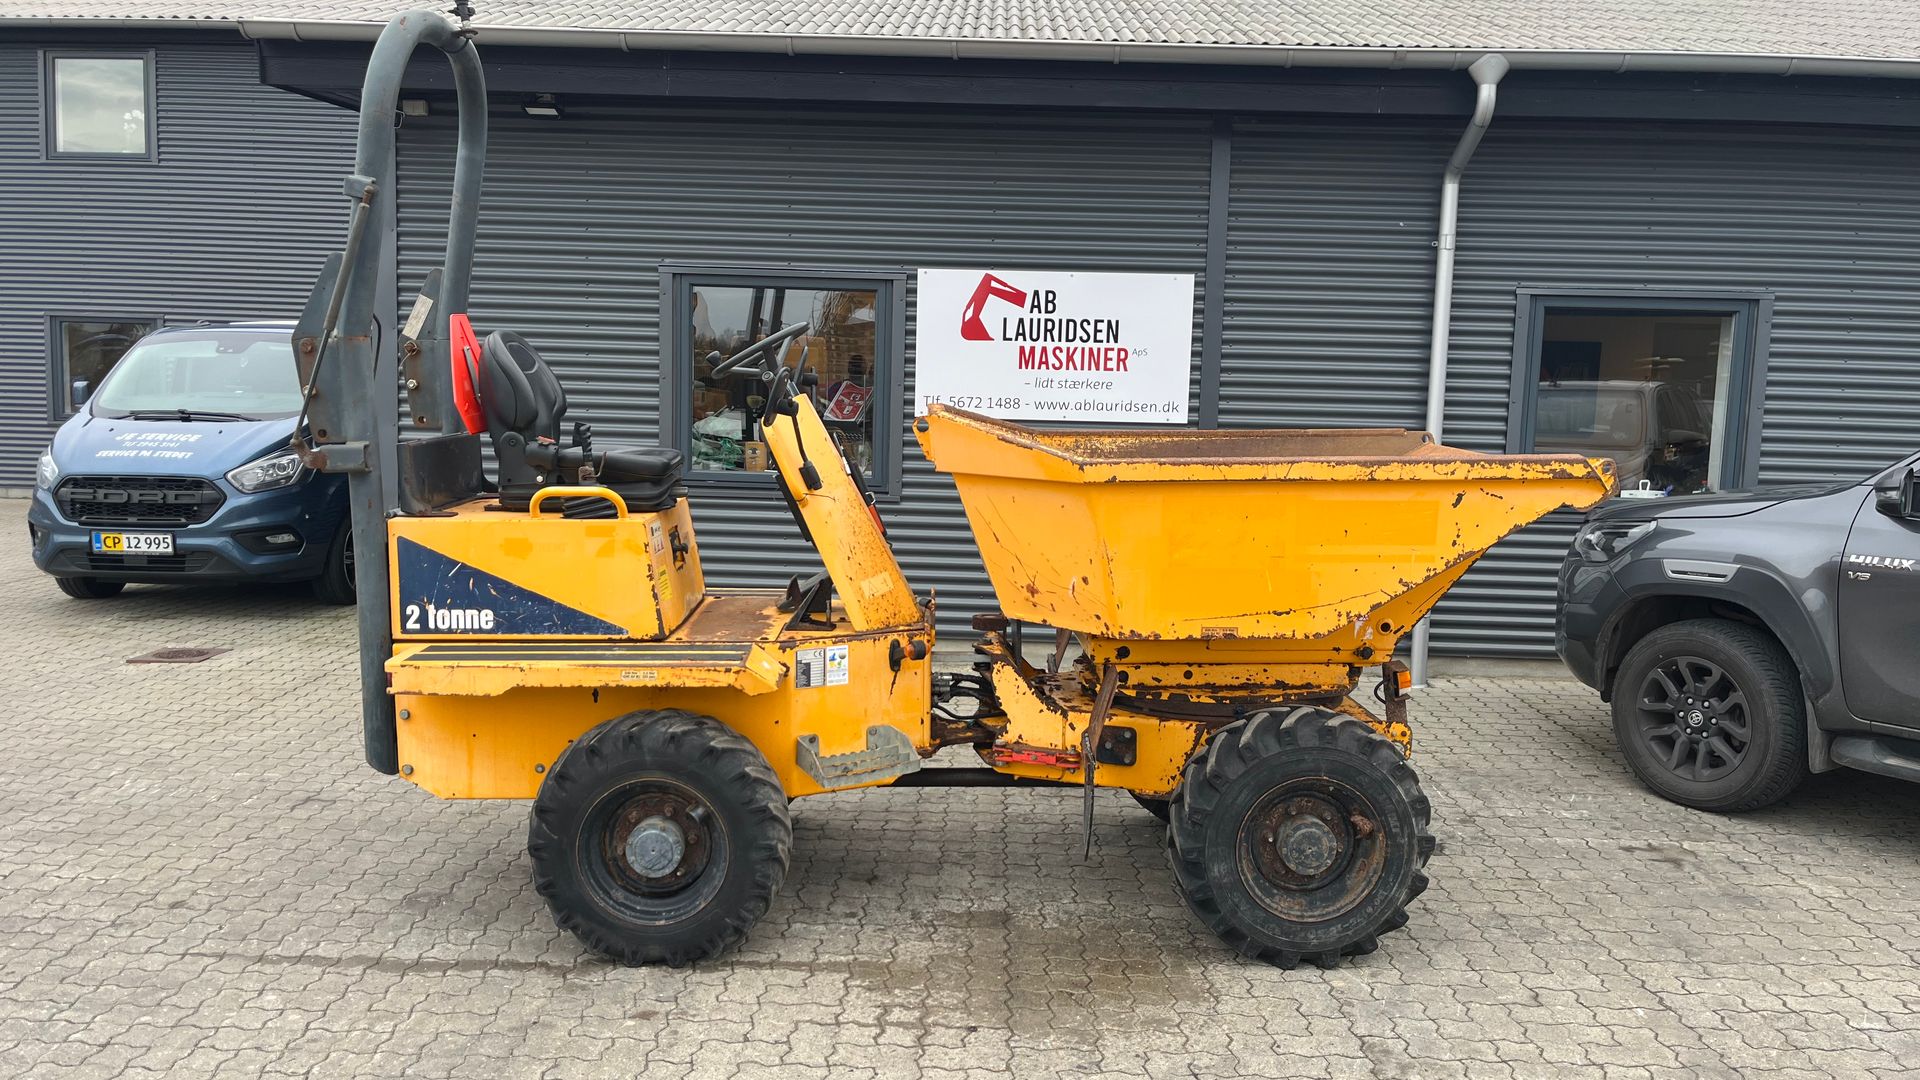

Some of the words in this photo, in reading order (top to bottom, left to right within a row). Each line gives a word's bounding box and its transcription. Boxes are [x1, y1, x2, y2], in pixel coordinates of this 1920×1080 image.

[1029, 289, 1057, 314] AB
[1002, 317, 1120, 344] LAURIDSEN
[1018, 345, 1129, 372] MASKINER
[1131, 348, 1148, 357] ApS
[1034, 377, 1054, 389] lidt
[1057, 379, 1113, 390] stærkere
[949, 396, 982, 409] 5672
[986, 397, 1021, 410] 1488
[1034, 399, 1180, 414] www.ablauridsen.dk
[138, 433, 202, 442] SERVICE
[67, 489, 203, 504] FORD
[103, 535, 121, 549] CP
[125, 536, 141, 549] 12
[144, 536, 170, 550] 995
[1848, 554, 1916, 571] HILUX
[1848, 571, 1871, 581] V6
[405, 604, 421, 630] 2
[427, 604, 495, 630] tonne
